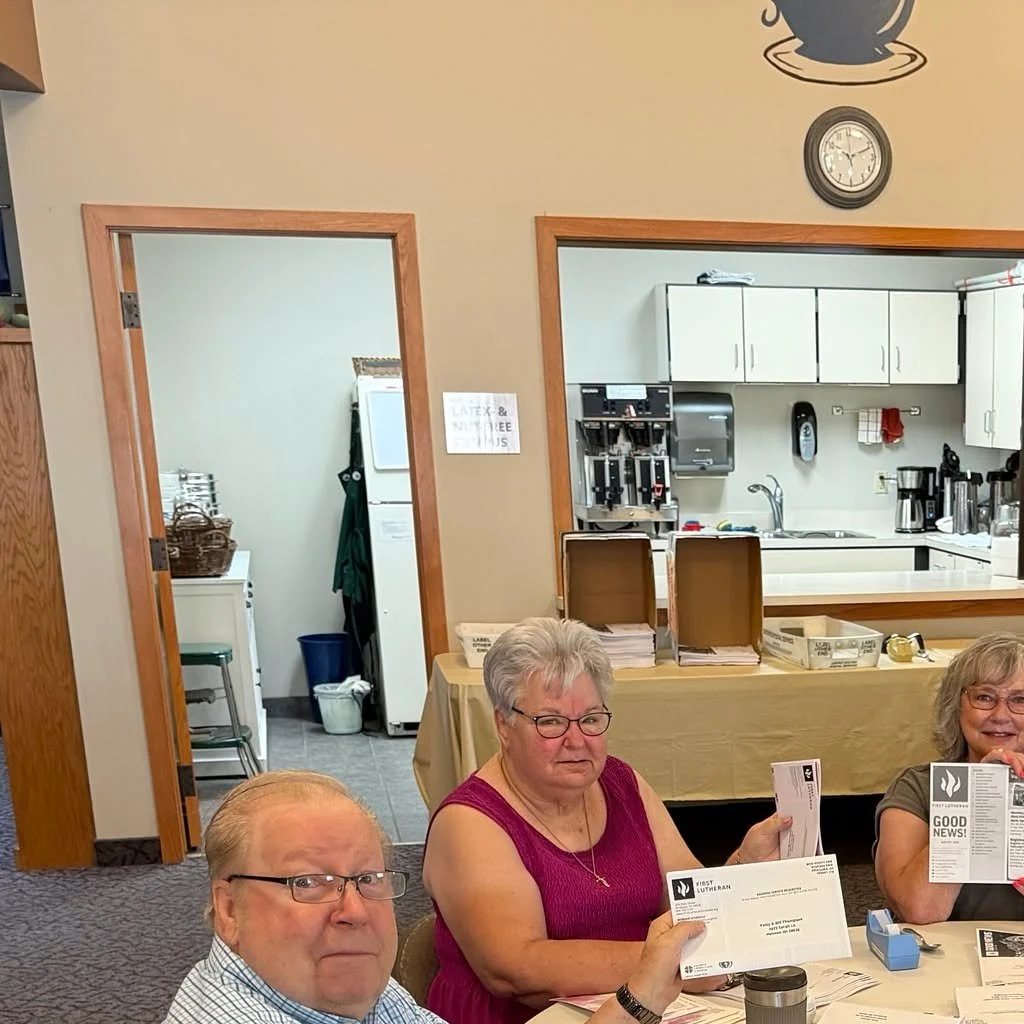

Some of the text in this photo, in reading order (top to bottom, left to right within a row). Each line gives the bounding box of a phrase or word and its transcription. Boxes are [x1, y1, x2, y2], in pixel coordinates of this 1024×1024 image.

[498, 406, 508, 417] &
[933, 815, 967, 828] GOOD
[933, 828, 967, 838] NEWS!
[696, 880, 714, 888] FIRST
[696, 884, 731, 894] LUTHERAN
